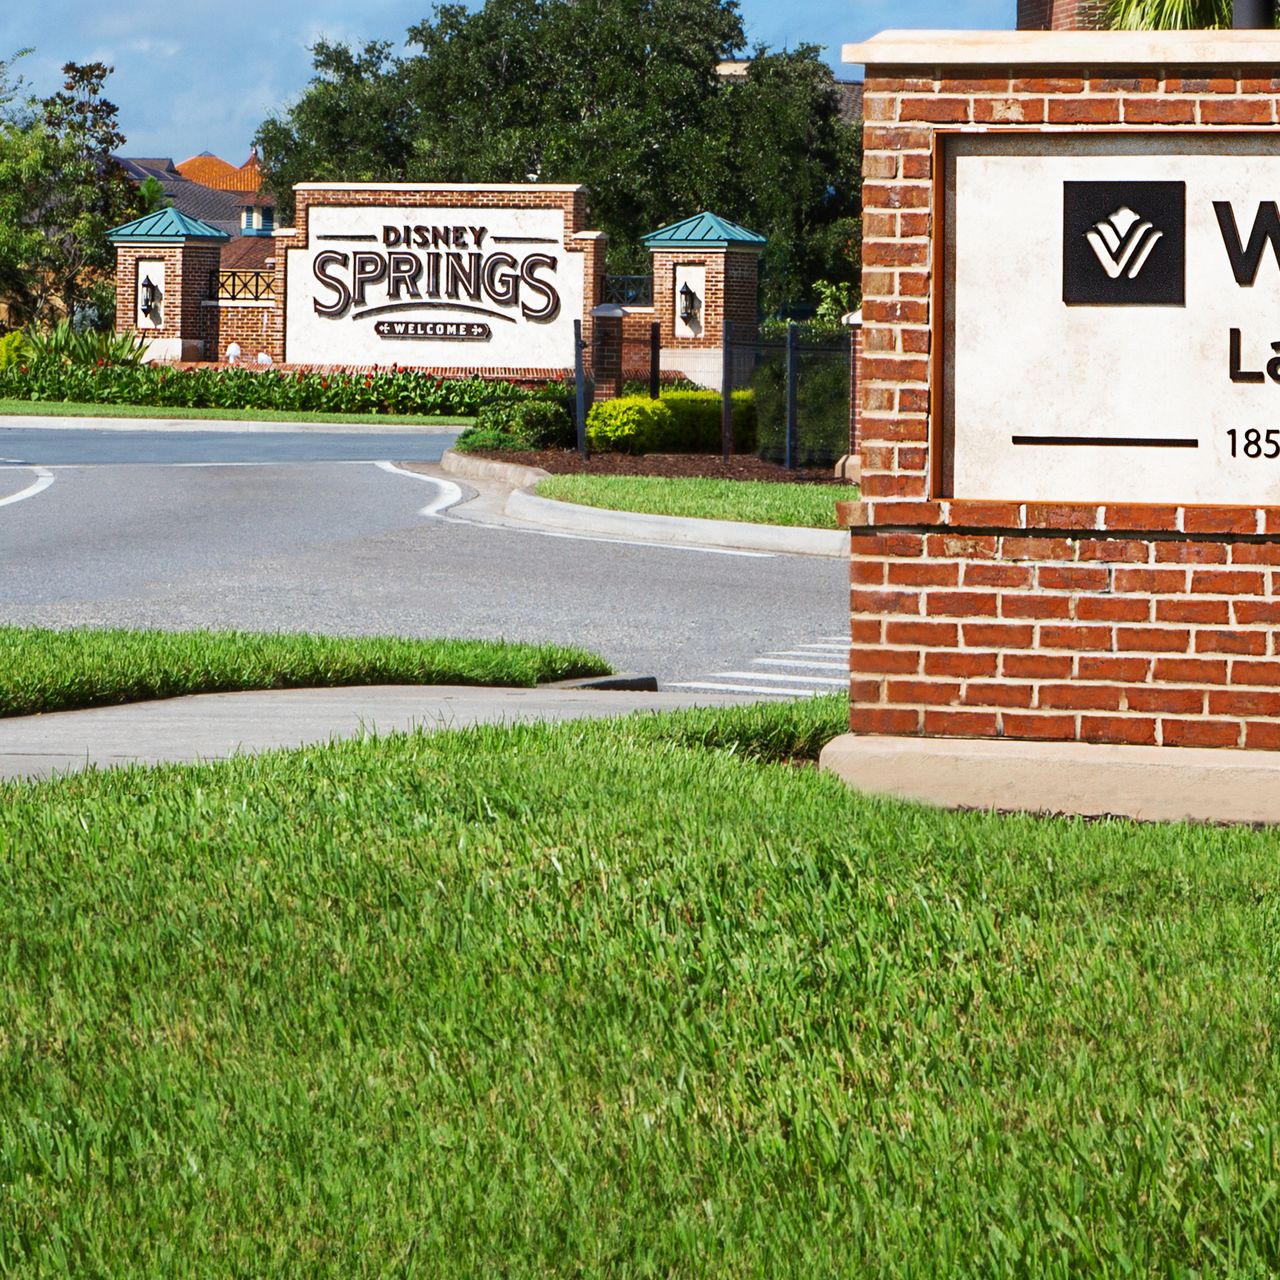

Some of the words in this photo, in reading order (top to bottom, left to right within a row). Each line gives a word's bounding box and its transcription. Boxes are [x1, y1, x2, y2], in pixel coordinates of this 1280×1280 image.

[382, 225, 488, 250] DISNEY
[312, 250, 561, 324] SPRINGS
[393, 323, 467, 335] WELCOME
